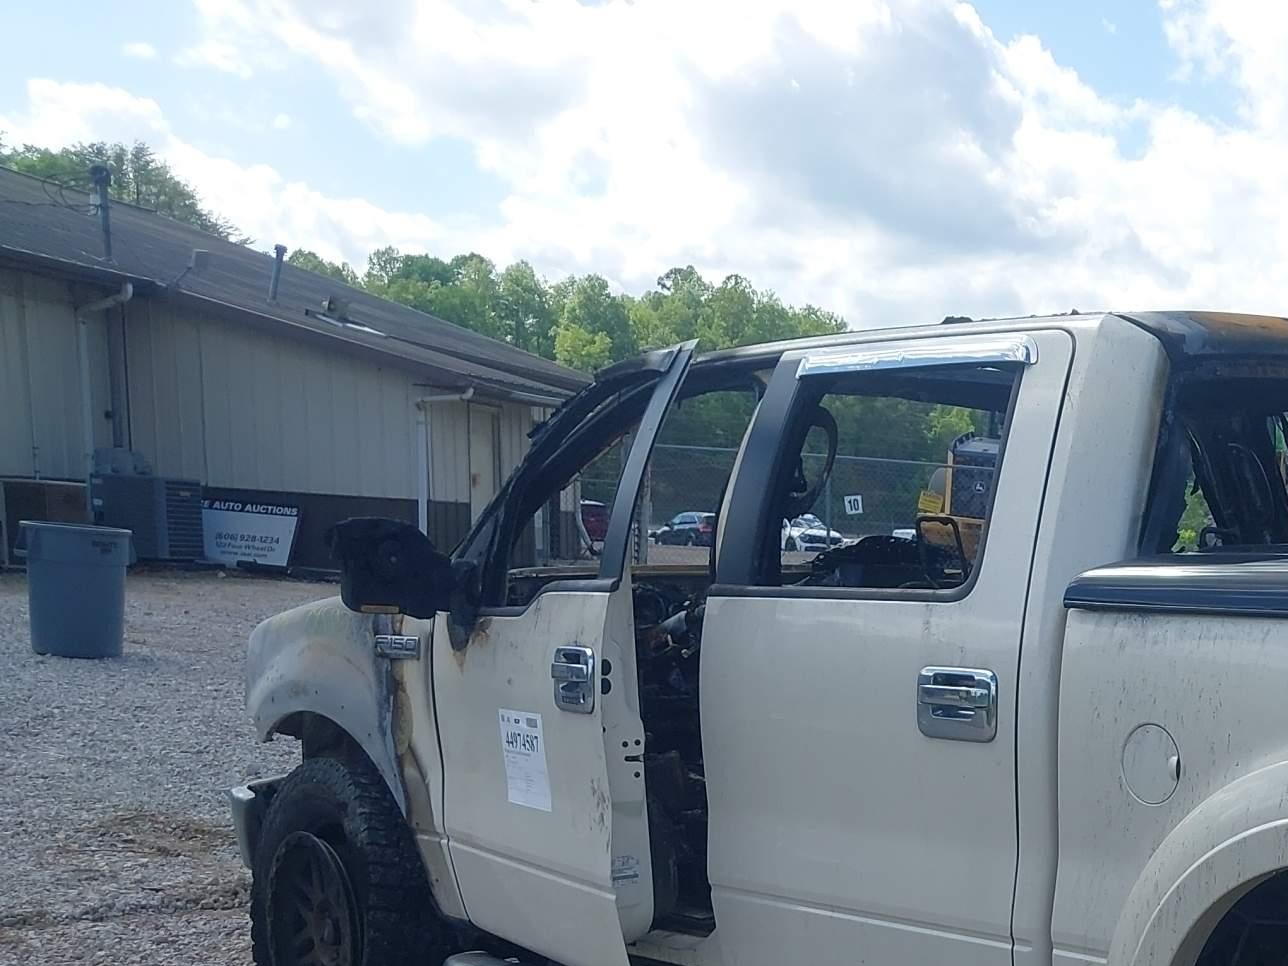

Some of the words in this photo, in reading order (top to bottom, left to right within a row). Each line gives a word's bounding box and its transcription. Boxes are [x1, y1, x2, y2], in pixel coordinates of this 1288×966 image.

[212, 500, 242, 511] AUTO
[244, 503, 298, 516] AUCTIONS
[847, 498, 860, 512] 10
[239, 534, 280, 545] 928-1234
[505, 731, 539, 753] 44974587
